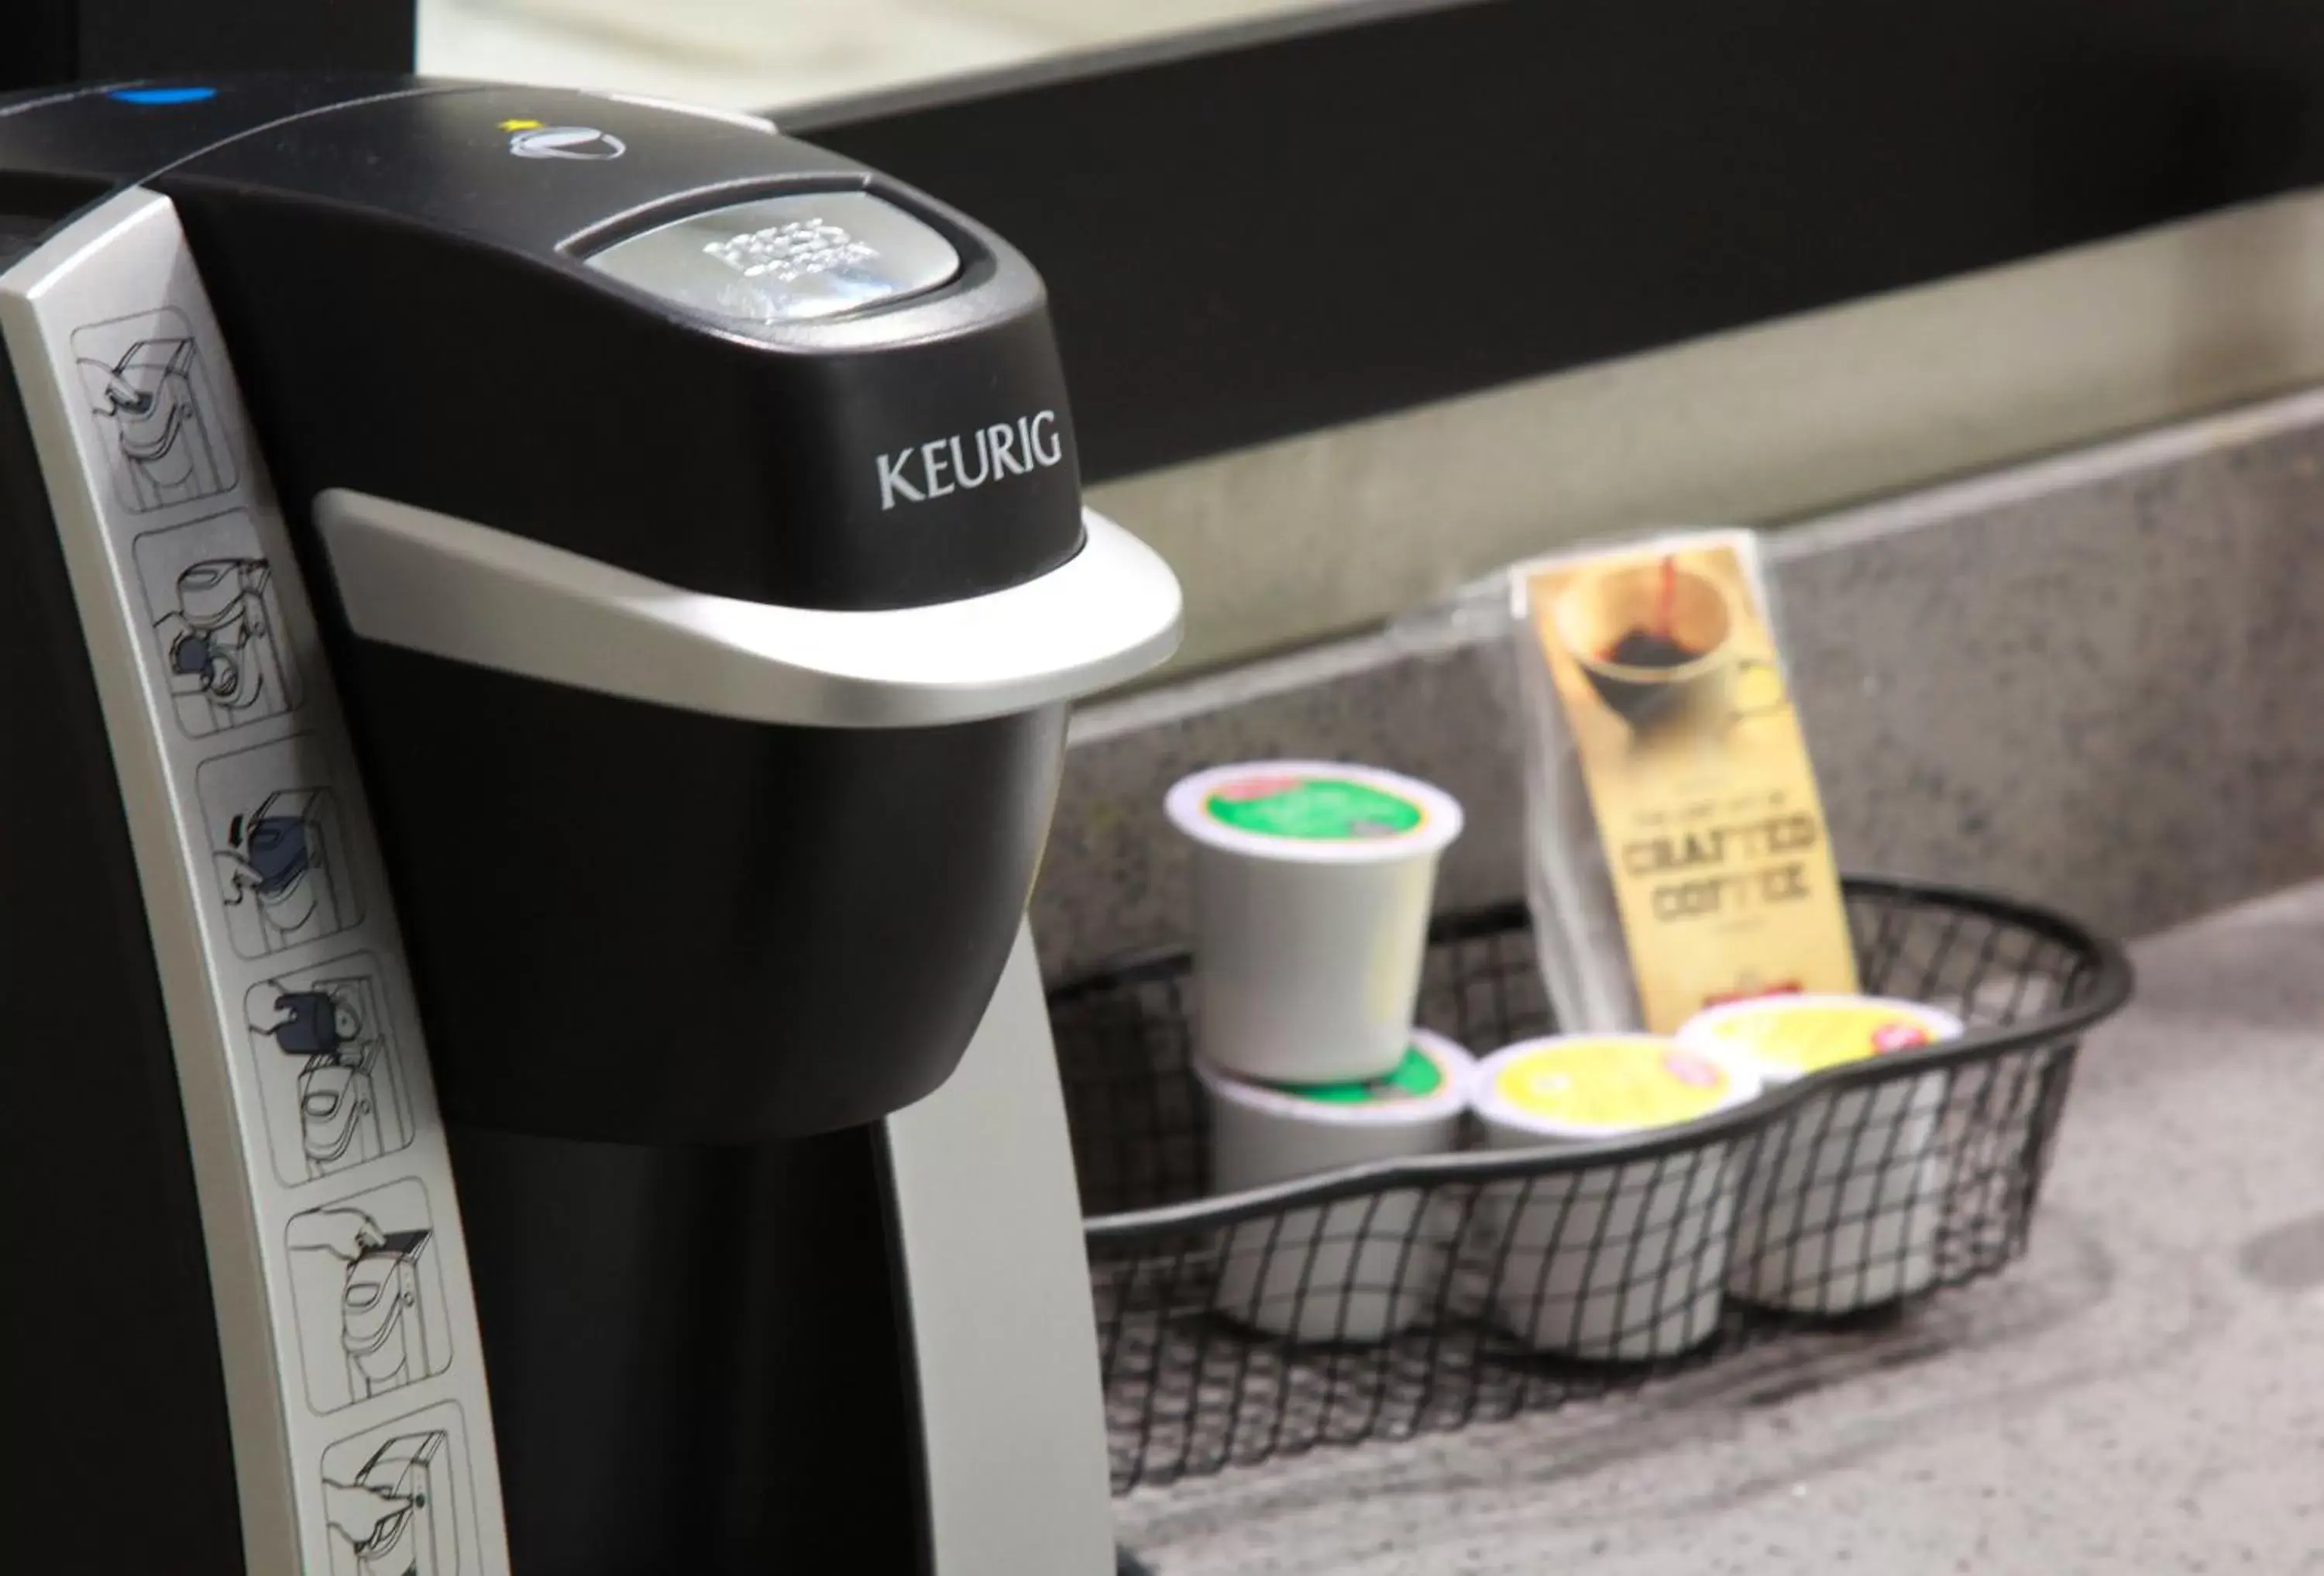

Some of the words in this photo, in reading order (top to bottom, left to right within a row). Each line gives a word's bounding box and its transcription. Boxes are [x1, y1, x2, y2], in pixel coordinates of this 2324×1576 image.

[875, 410, 1062, 510] KEURIG
[1623, 813, 1816, 879] CRAFTED
[1651, 862, 1810, 921] COFFEE
